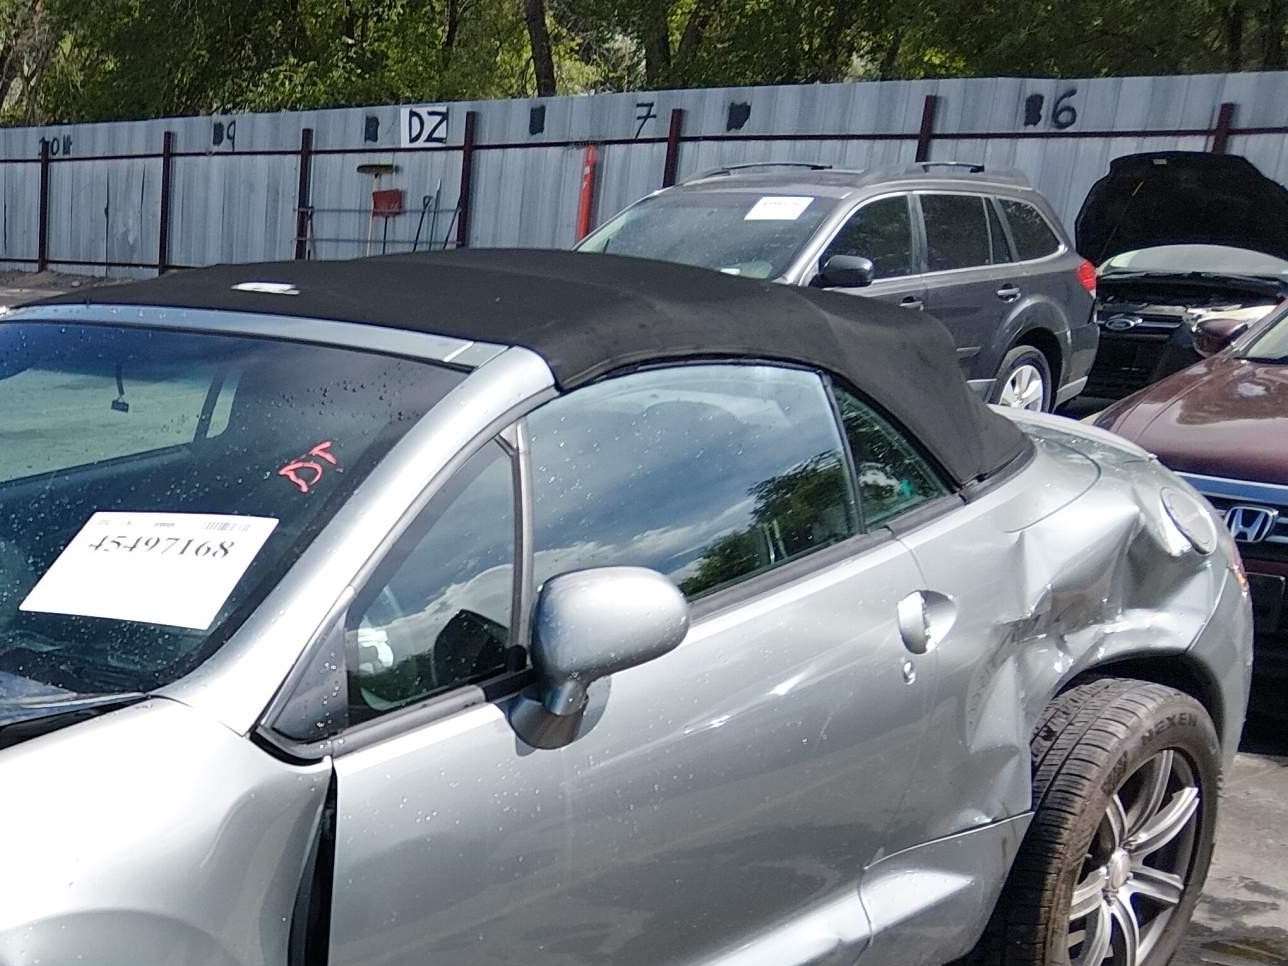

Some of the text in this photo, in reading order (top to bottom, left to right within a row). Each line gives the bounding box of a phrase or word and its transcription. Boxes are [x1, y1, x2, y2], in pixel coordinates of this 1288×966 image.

[635, 102, 657, 139] 7
[88, 534, 235, 559] 45497168
[1140, 711, 1199, 747] NEXEN
